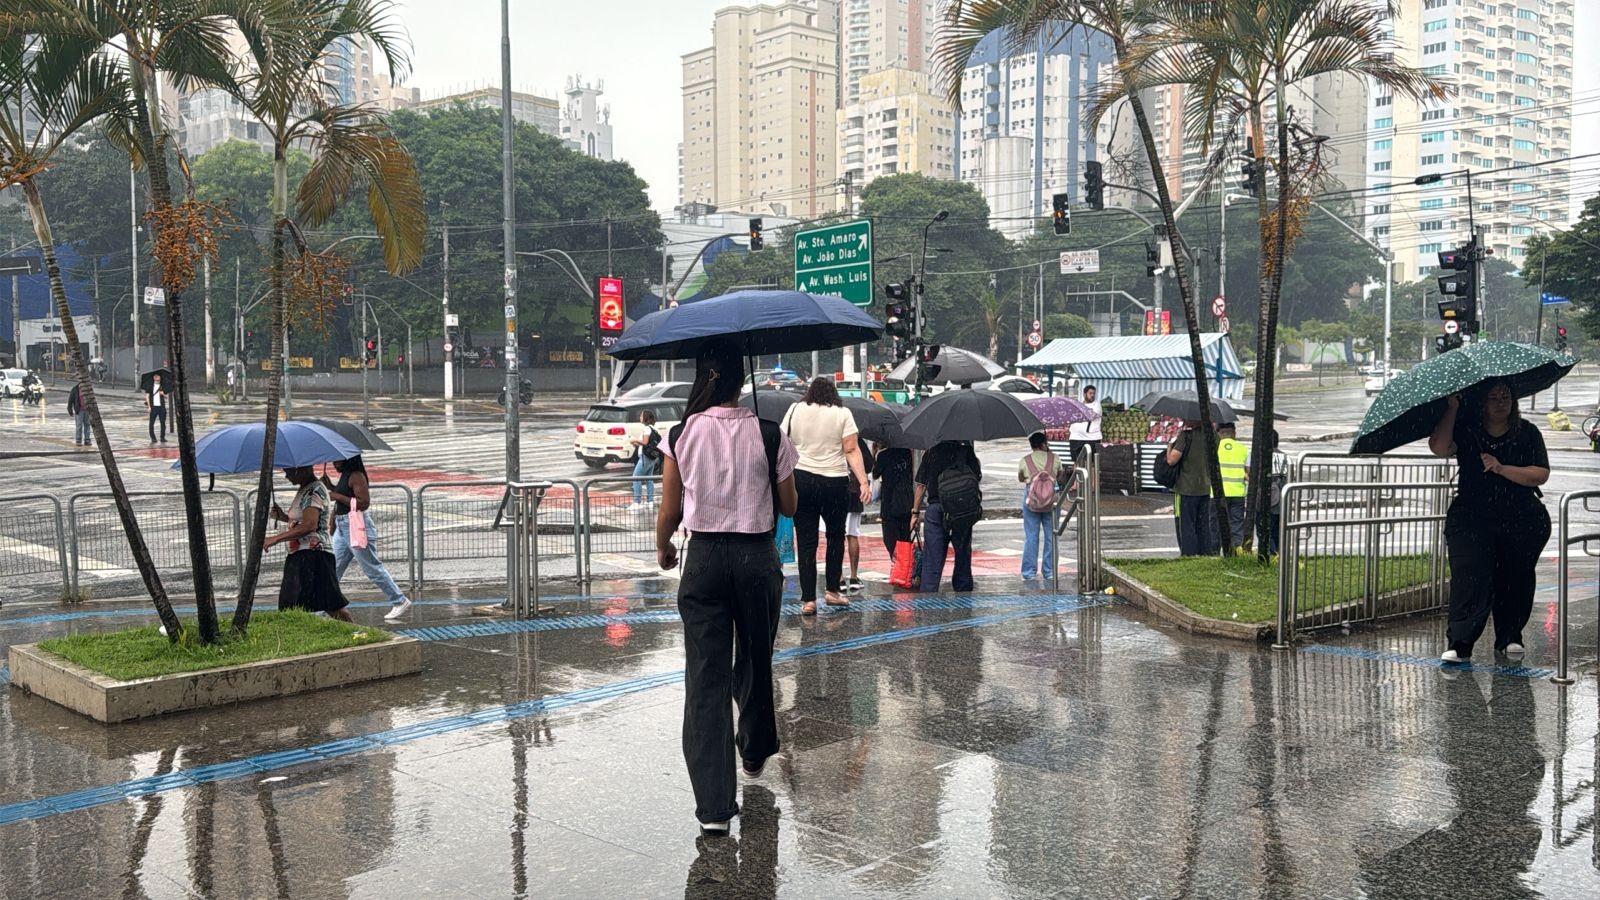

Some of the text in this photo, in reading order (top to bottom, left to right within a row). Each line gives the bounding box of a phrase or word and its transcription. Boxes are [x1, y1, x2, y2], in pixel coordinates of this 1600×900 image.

[798, 233, 856, 250] Av. Sto. Amaro
[803, 249, 856, 265] Av. João Dias
[809, 276, 820, 287] Av.
[823, 274, 845, 285] Wash.
